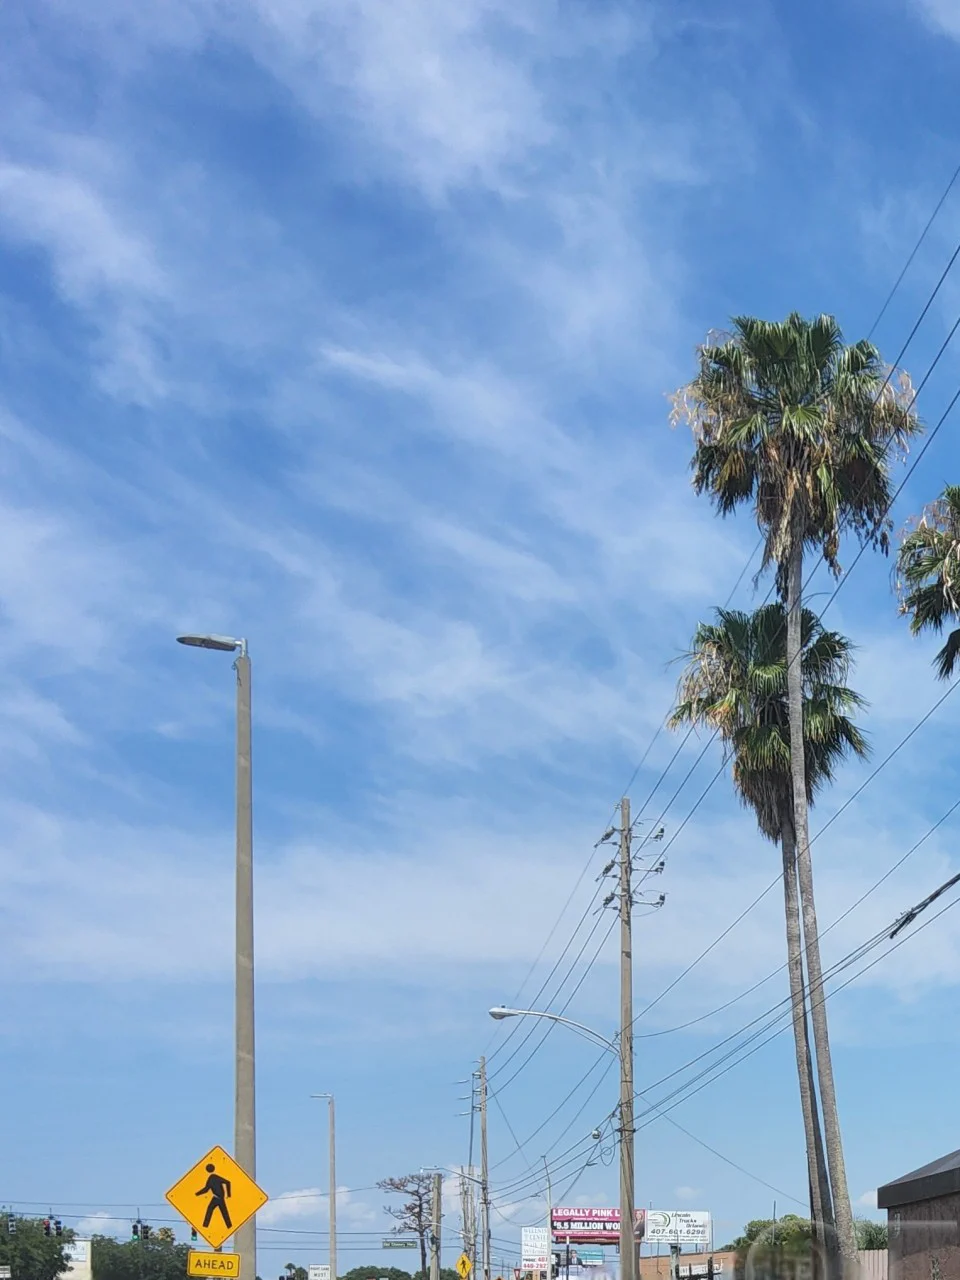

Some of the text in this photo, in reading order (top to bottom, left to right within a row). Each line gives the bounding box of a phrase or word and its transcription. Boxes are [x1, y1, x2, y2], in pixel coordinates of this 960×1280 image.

[552, 1208, 590, 1217] LEGALLY
[592, 1209, 613, 1217] PINK
[570, 1221, 604, 1230] MILLION
[195, 1259, 234, 1270] AHEAD
